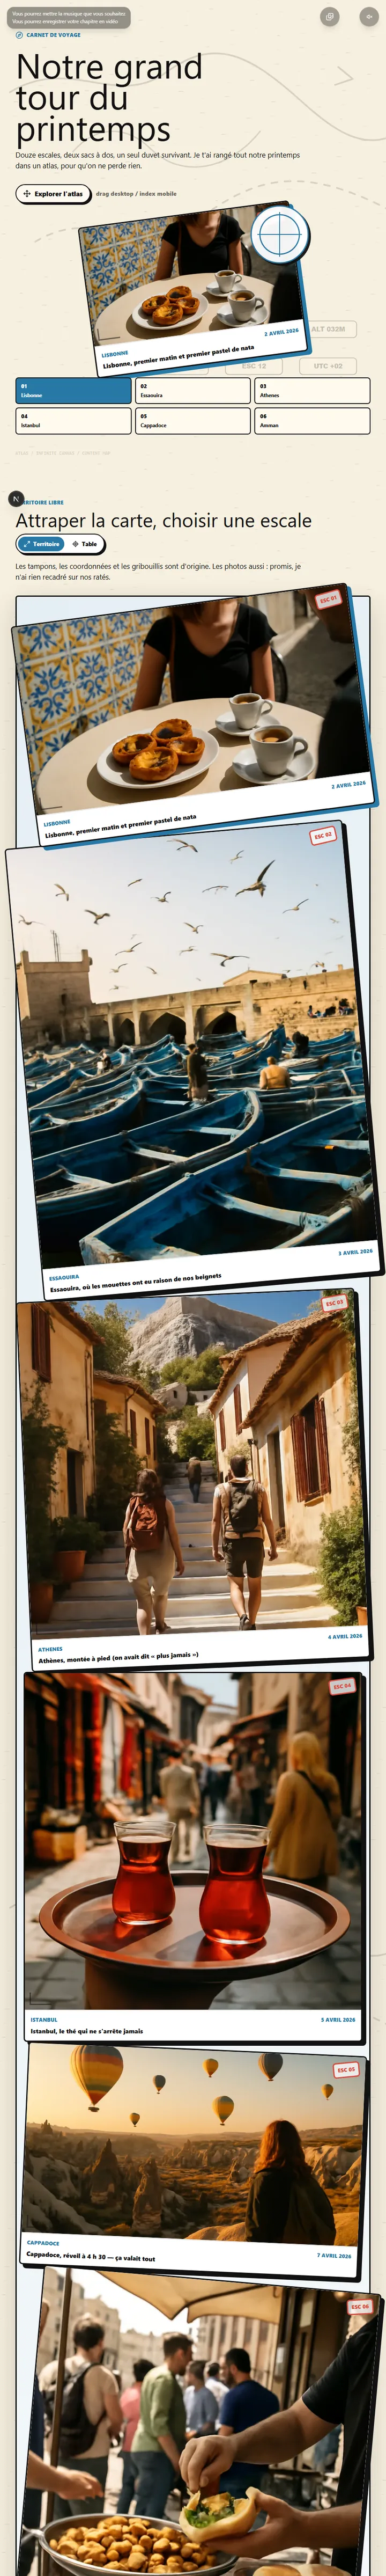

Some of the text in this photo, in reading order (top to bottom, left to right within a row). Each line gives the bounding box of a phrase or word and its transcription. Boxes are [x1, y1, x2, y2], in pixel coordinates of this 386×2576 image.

[18, 53, 201, 87] Notre grand
[16, 84, 127, 111] tour du
[18, 115, 170, 150] printemps
[108, 163, 127, 171] perde
[133, 357, 158, 367] premier
[186, 351, 211, 360] premier
[212, 347, 231, 356] pastel
[16, 513, 311, 532] Attraper la carte, choisir une escale
